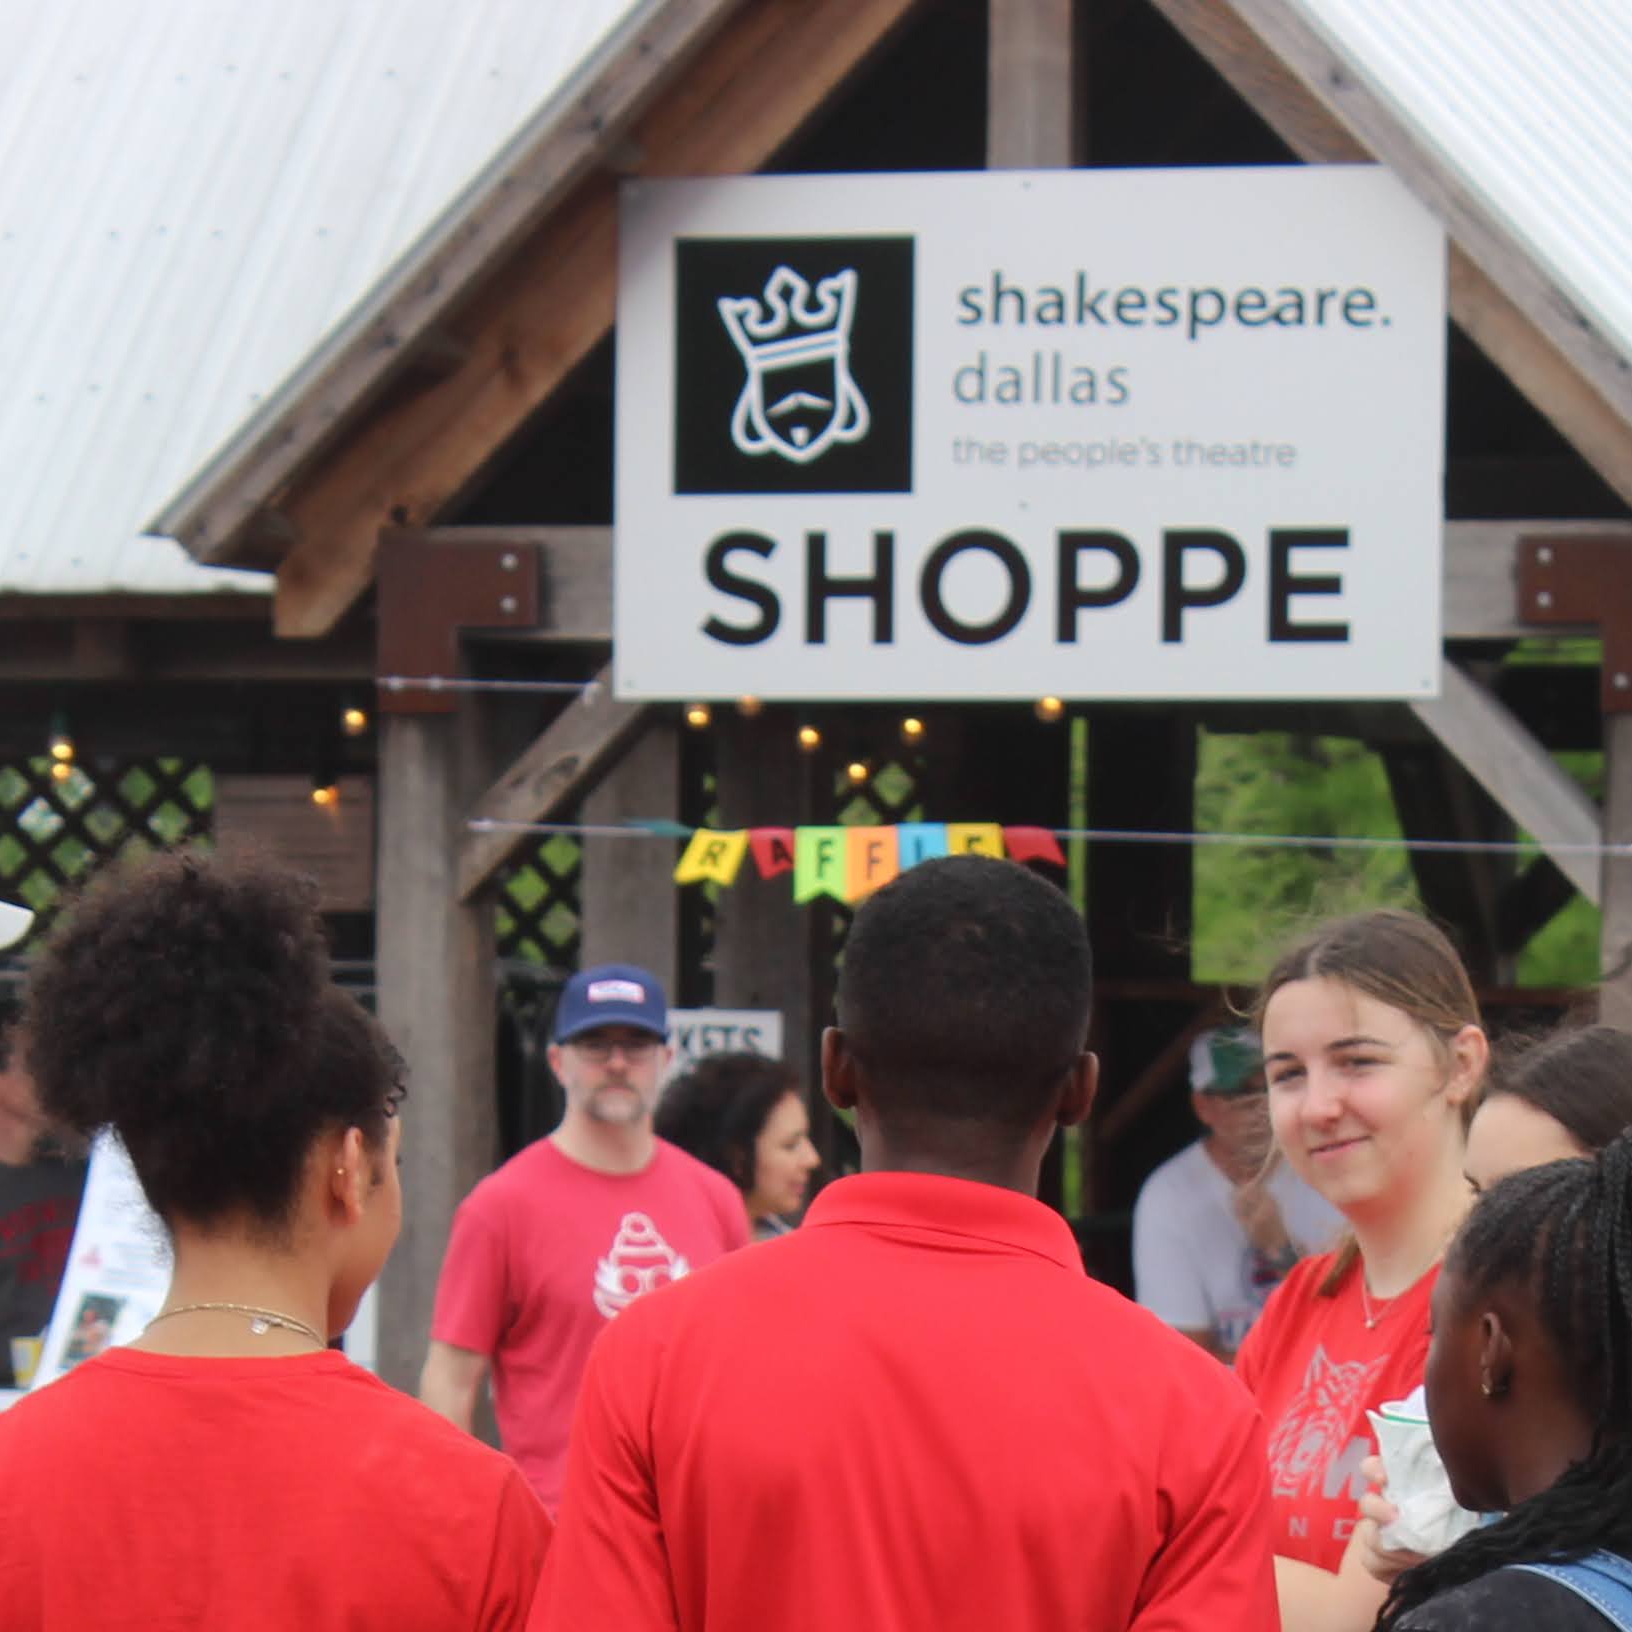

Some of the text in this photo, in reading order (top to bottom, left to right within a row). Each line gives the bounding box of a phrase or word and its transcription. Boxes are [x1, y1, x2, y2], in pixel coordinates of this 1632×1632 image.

[957, 270, 1391, 342] shakespeare.
[952, 350, 1129, 406] dallas
[951, 435, 1298, 471] the people's theatre
[701, 528, 1351, 648] SHOPPE
[675, 1023, 764, 1056] KETS
